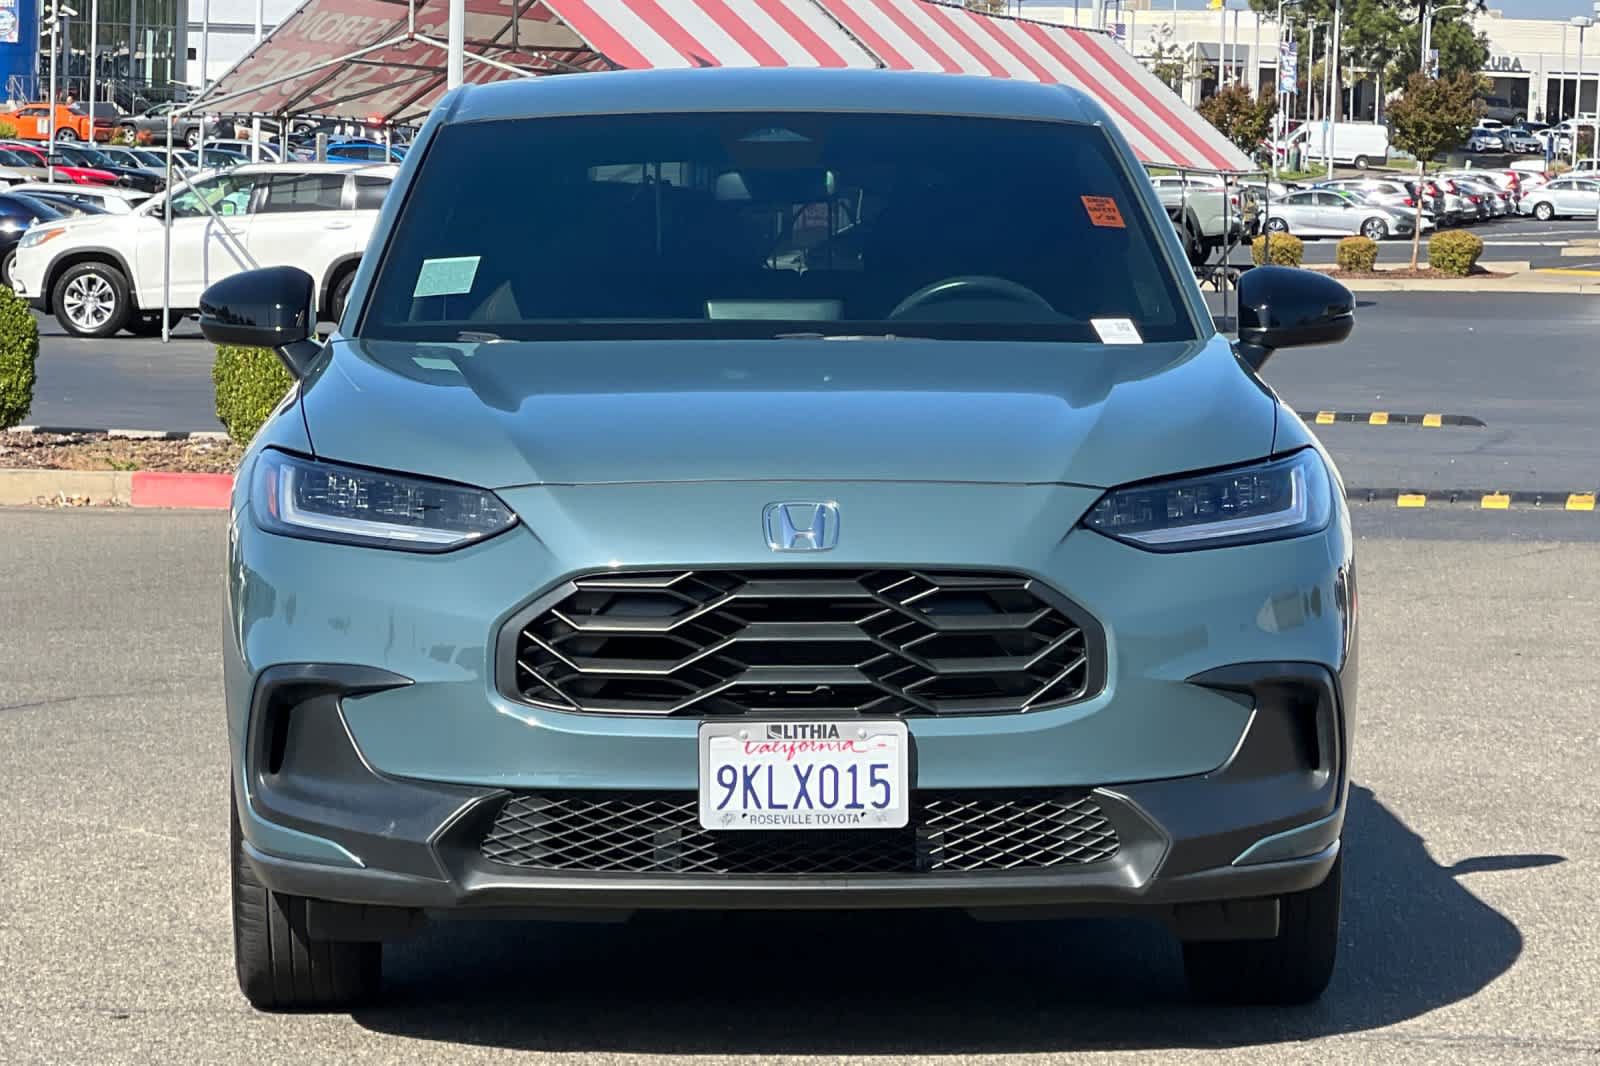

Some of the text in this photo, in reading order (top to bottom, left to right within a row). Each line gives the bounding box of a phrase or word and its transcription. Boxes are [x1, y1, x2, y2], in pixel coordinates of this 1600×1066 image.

[784, 724, 840, 740] LITHIA
[744, 740, 867, 760] California
[716, 763, 891, 810] 9KLX015
[749, 813, 860, 825] ROSEVILLE TOYOTA
